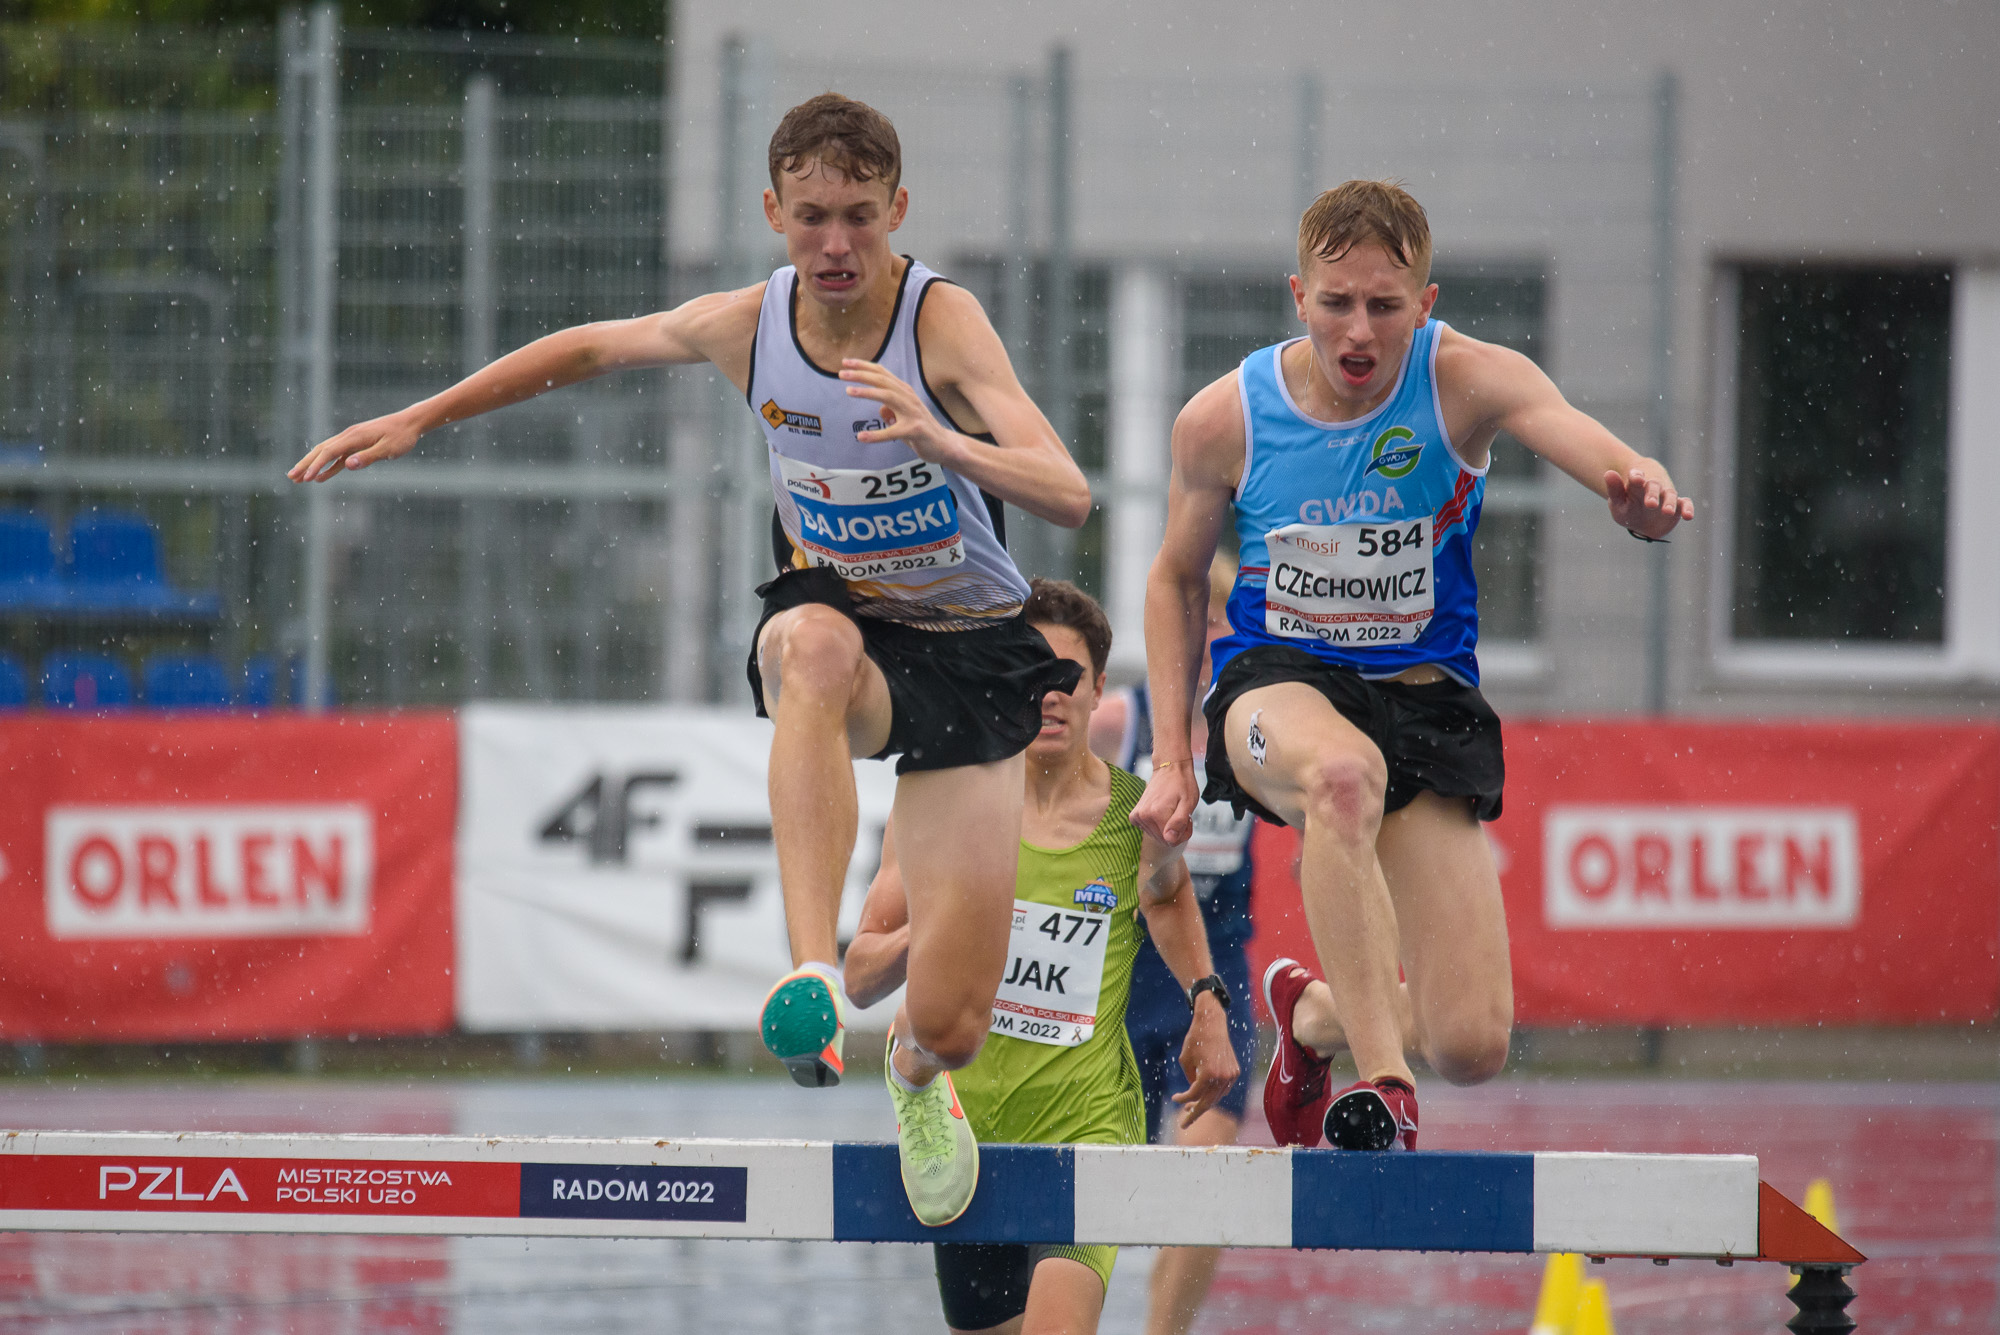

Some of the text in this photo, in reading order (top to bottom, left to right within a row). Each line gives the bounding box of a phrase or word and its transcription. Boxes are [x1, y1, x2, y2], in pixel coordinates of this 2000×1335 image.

[786, 413, 820, 428] OPTIMA
[1379, 453, 1407, 465] GWDA
[787, 478, 821, 495] polanik
[861, 462, 932, 500] 255
[1299, 486, 1404, 525] GWDA
[798, 499, 952, 542] BAJORSKI
[805, 542, 828, 556] PZLA
[900, 544, 939, 557] POLSKI
[940, 535, 961, 549] U20
[1296, 537, 1341, 554] mosir
[1357, 523, 1424, 557] 584
[891, 556, 938, 571] 2022
[1275, 563, 1427, 602] CZECHOWICZ
[1270, 602, 1431, 622] PZLA MISTRZOSTWA POLSKI U20
[1280, 617, 1401, 641] RADOM 2022
[538, 769, 681, 866] 4F
[70, 834, 346, 911] ORLEN
[1569, 832, 1832, 903] ORLEN
[1075, 889, 1117, 908] MKS
[1039, 912, 1103, 946] 477
[1004, 957, 1071, 995] JAK
[1037, 1009, 1071, 1021] POLSKI
[1071, 1016, 1092, 1025] U20
[1019, 1020, 1061, 1040] 2022
[99, 1166, 250, 1202] PZLA
[277, 1168, 453, 1187] MISTRZOSTWA
[276, 1187, 417, 1205] POLSKI U20
[552, 1178, 715, 1204] RADOM 2022
